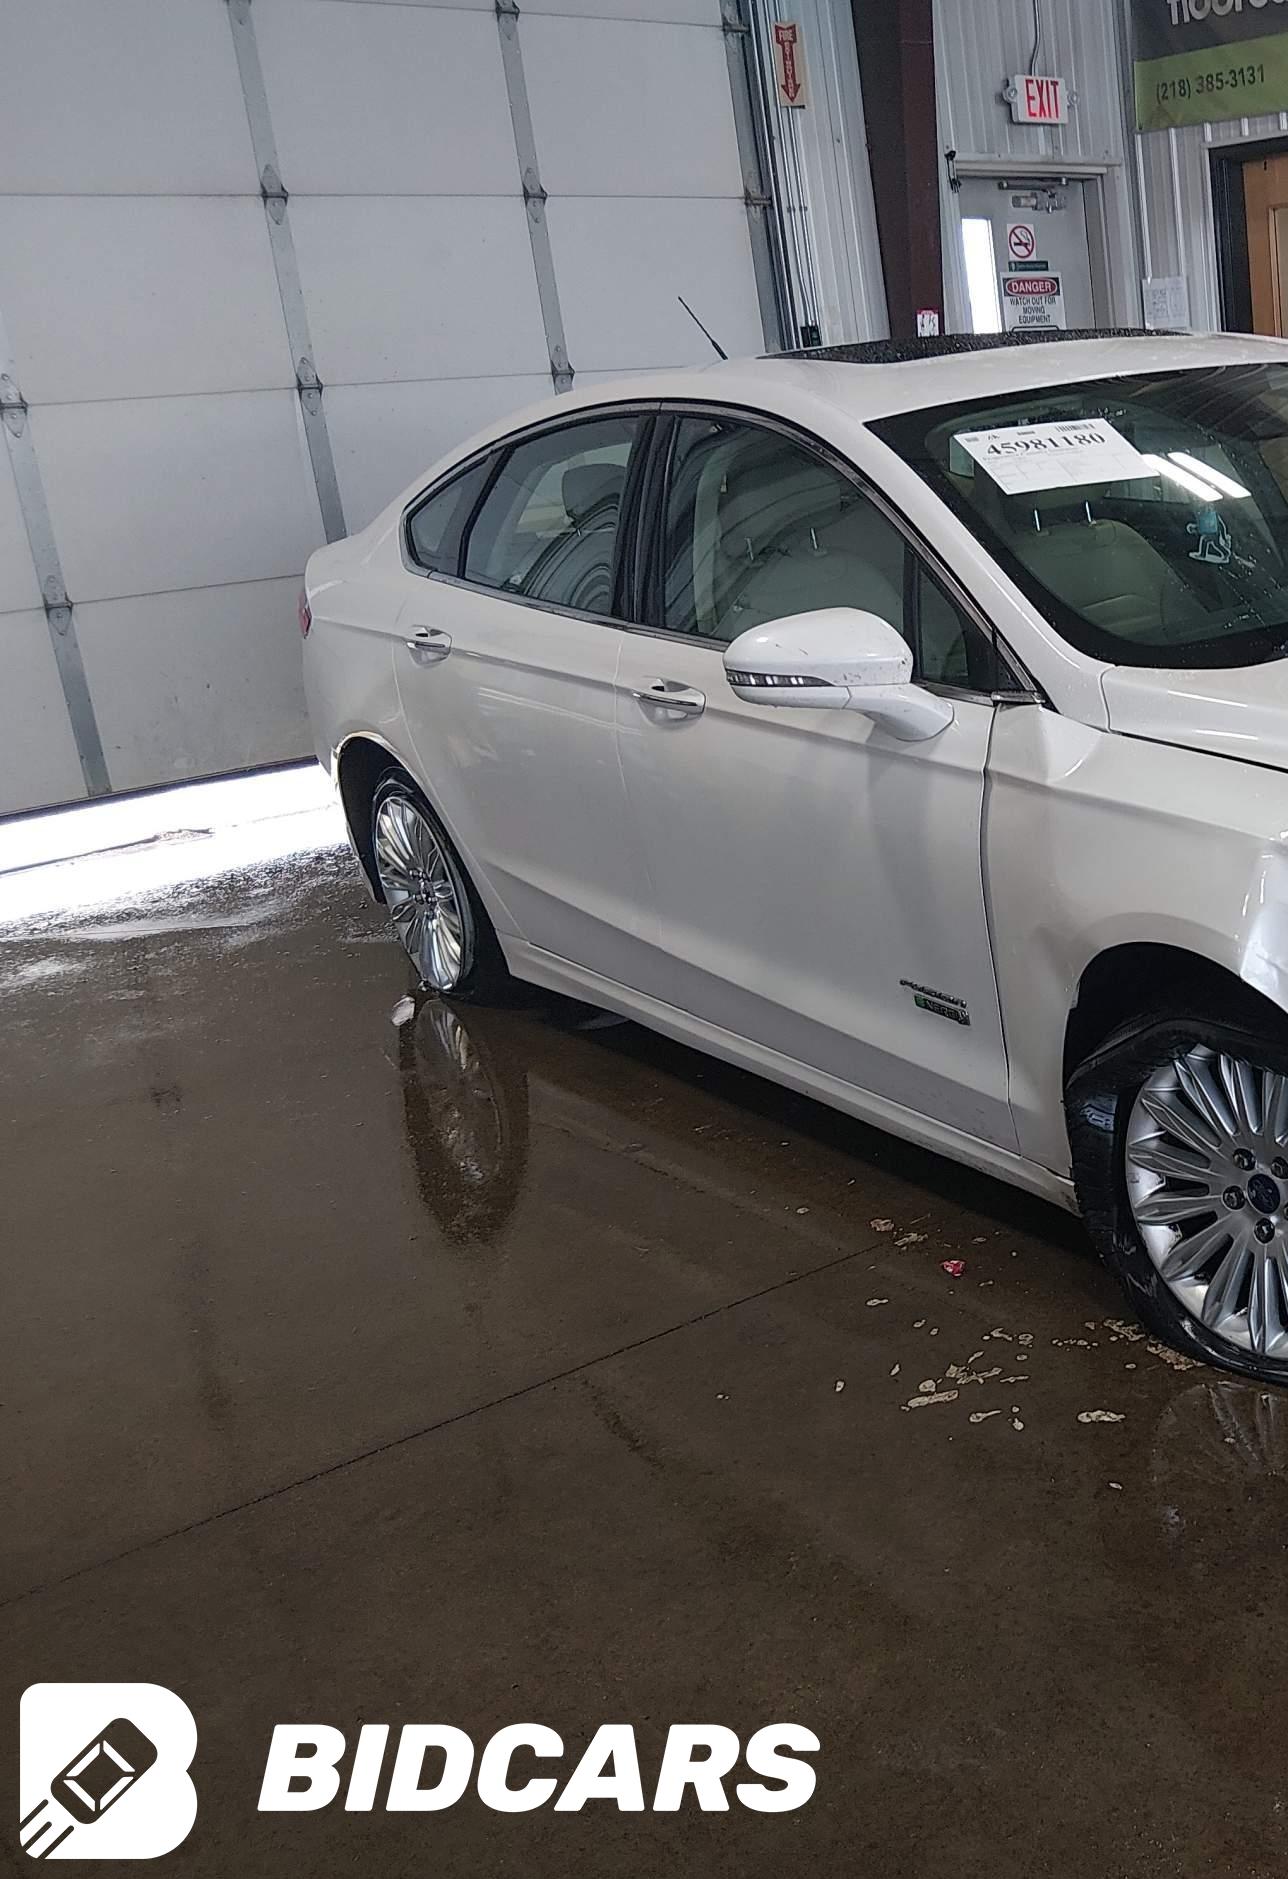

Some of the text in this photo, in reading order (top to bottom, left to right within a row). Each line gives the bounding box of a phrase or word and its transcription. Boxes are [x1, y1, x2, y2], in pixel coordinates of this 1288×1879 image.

[1156, 64, 1265, 104] (218) 385-3131
[1025, 79, 1059, 119] EXIT
[1011, 281, 1052, 293] DANGER
[1010, 296, 1056, 306] WATCH OUT FOR
[1022, 306, 1046, 315] MOVING
[1018, 315, 1051, 324] EQUIPMENT
[987, 432, 1106, 456] 45981180
